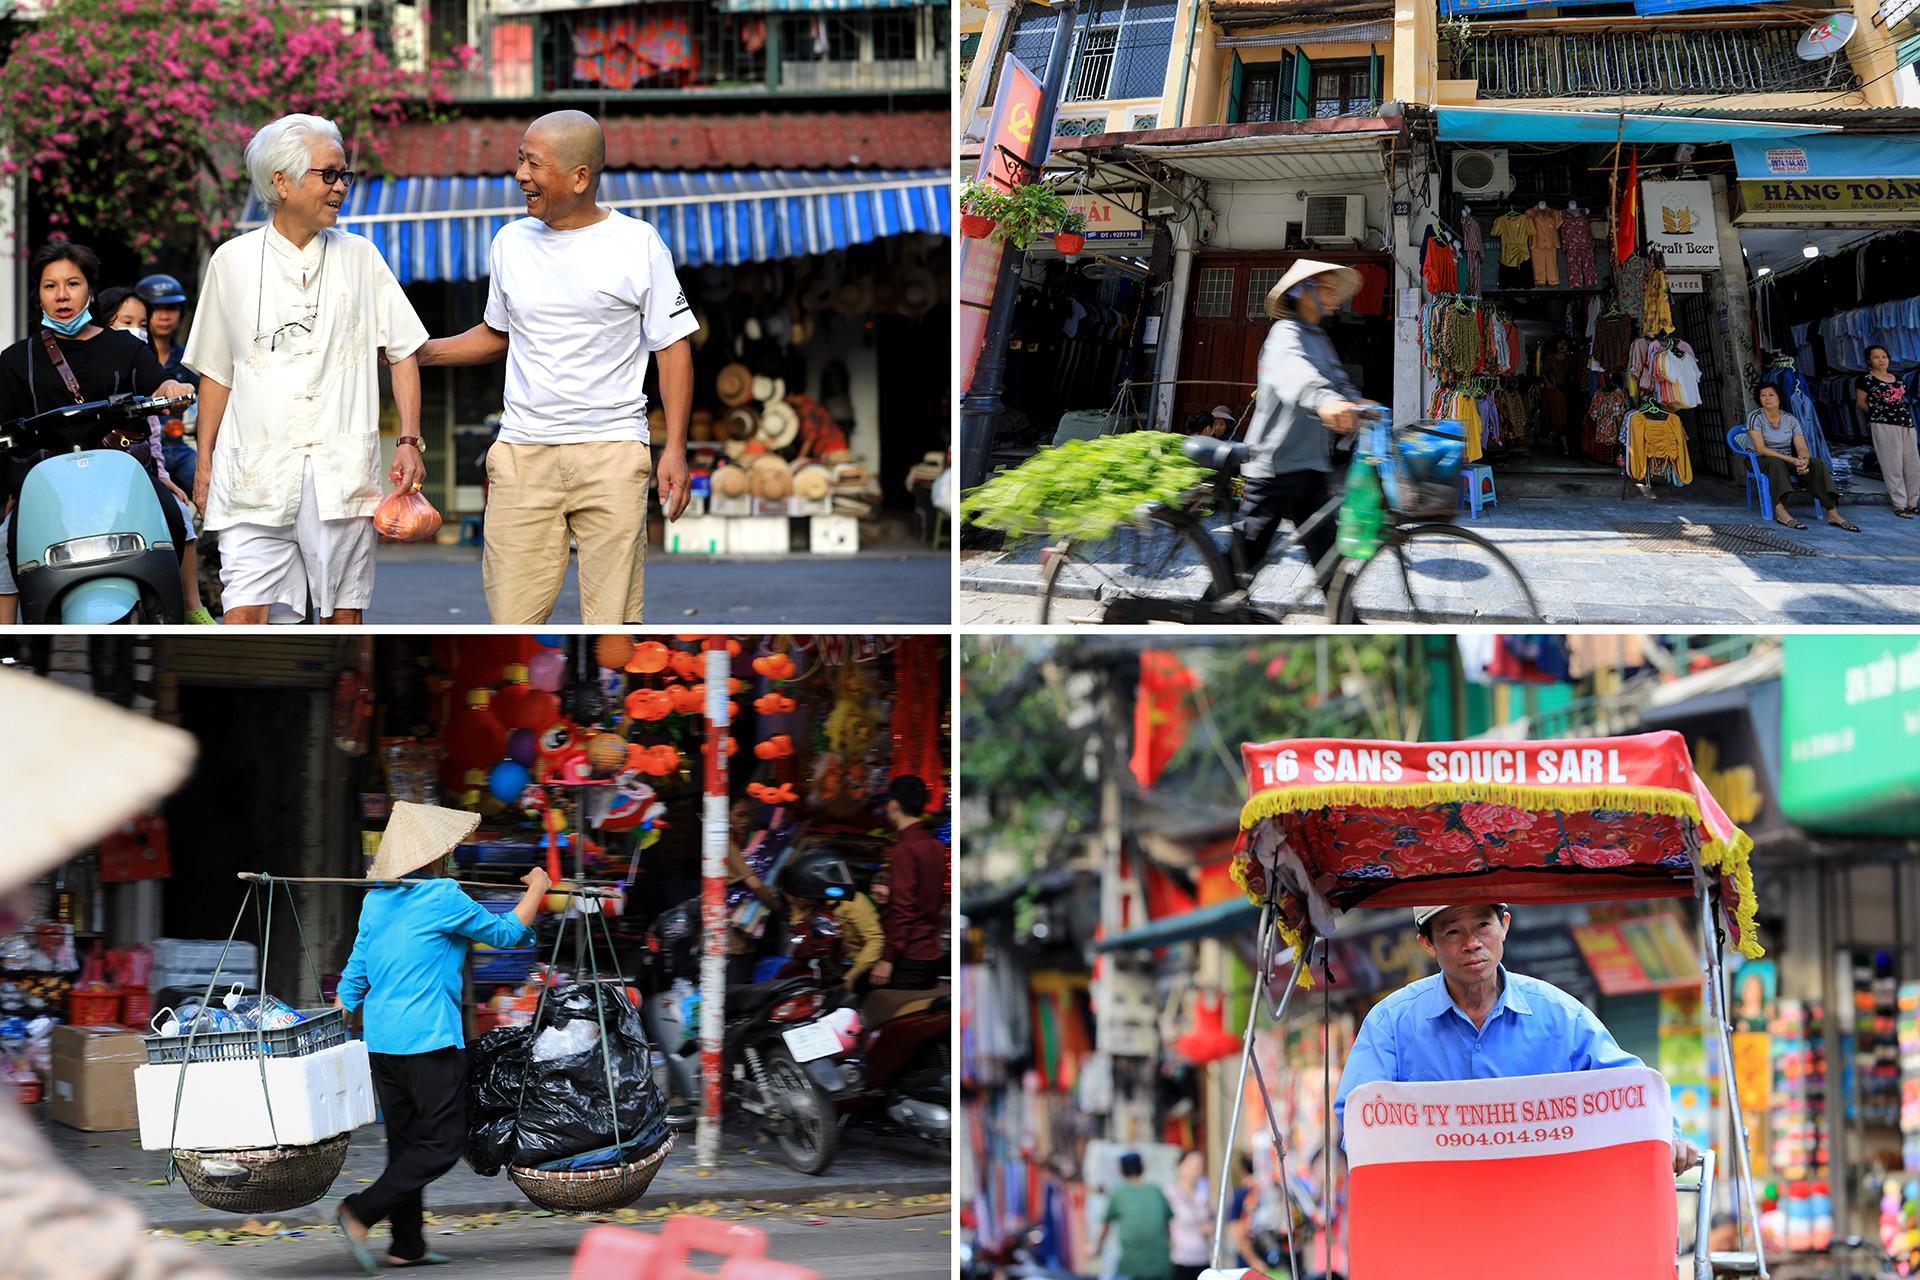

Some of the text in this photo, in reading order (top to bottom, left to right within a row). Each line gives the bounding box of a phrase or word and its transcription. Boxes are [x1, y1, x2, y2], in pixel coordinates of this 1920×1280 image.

[1396, 204, 1408, 214] 22
[1685, 242, 1714, 254] Beer
[1314, 749, 1403, 782] SANS
[1426, 750, 1526, 782] SOUCI
[1361, 1085, 1646, 1127] CÔNG TY TNHH SANS SOUCI
[1435, 1125, 1574, 1147] 0904.014.949
